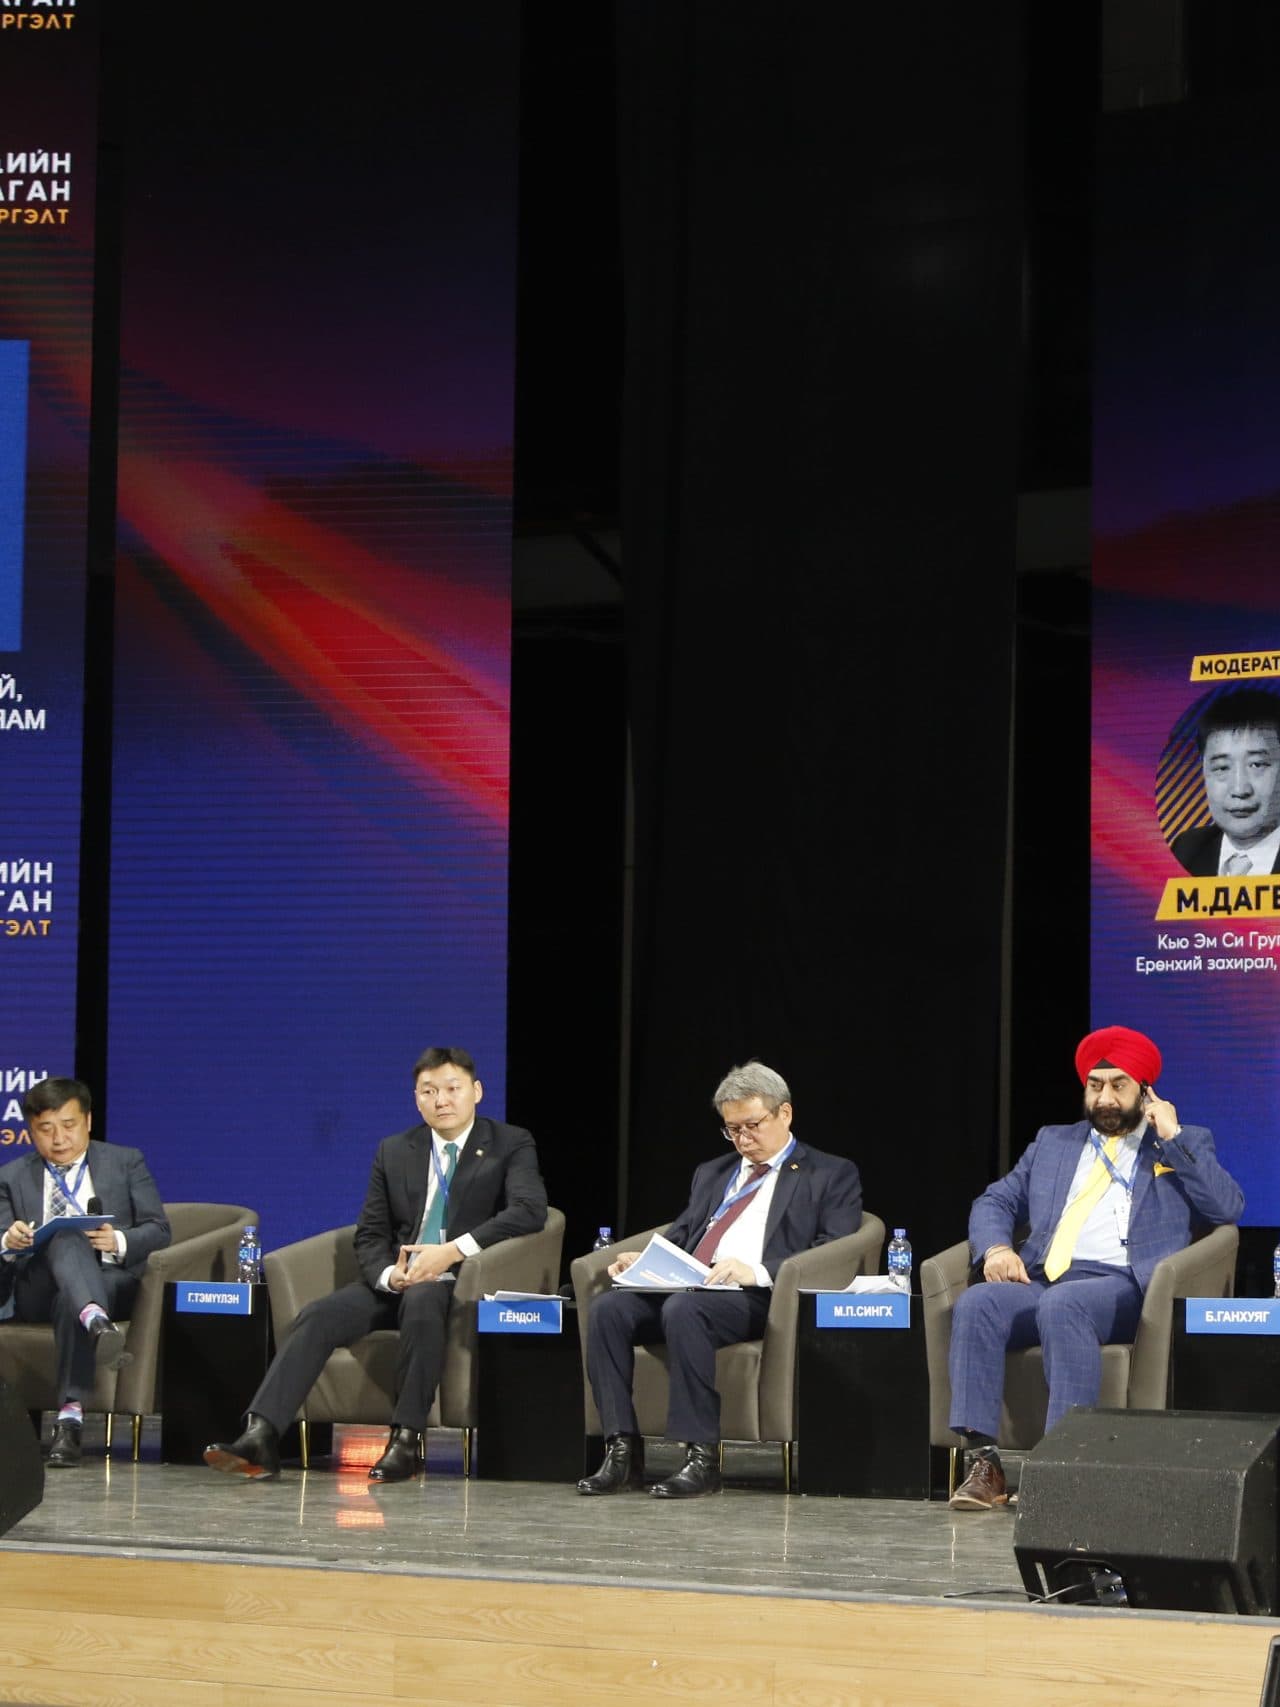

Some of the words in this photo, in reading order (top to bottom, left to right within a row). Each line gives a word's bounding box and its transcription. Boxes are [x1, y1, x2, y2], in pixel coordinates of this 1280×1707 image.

[0, 149, 71, 174] ИЙН
[0, 890, 52, 912] АН
[0, 919, 51, 936] ЭЛТ
[1158, 934, 1189, 949] Кью
[1194, 933, 1217, 948] Эм
[1222, 932, 1244, 947] Си
[1136, 956, 1202, 973] Ерөнхий
[1208, 956, 1277, 972] захирал,
[187, 1292, 239, 1304] Г.ТЭМҮҮЛЭН
[499, 1310, 540, 1324] Г.ЁНДОН
[834, 1306, 893, 1317] М.П.СИНГХ
[1205, 1311, 1270, 1323] Б.ГАНХУЯГ
